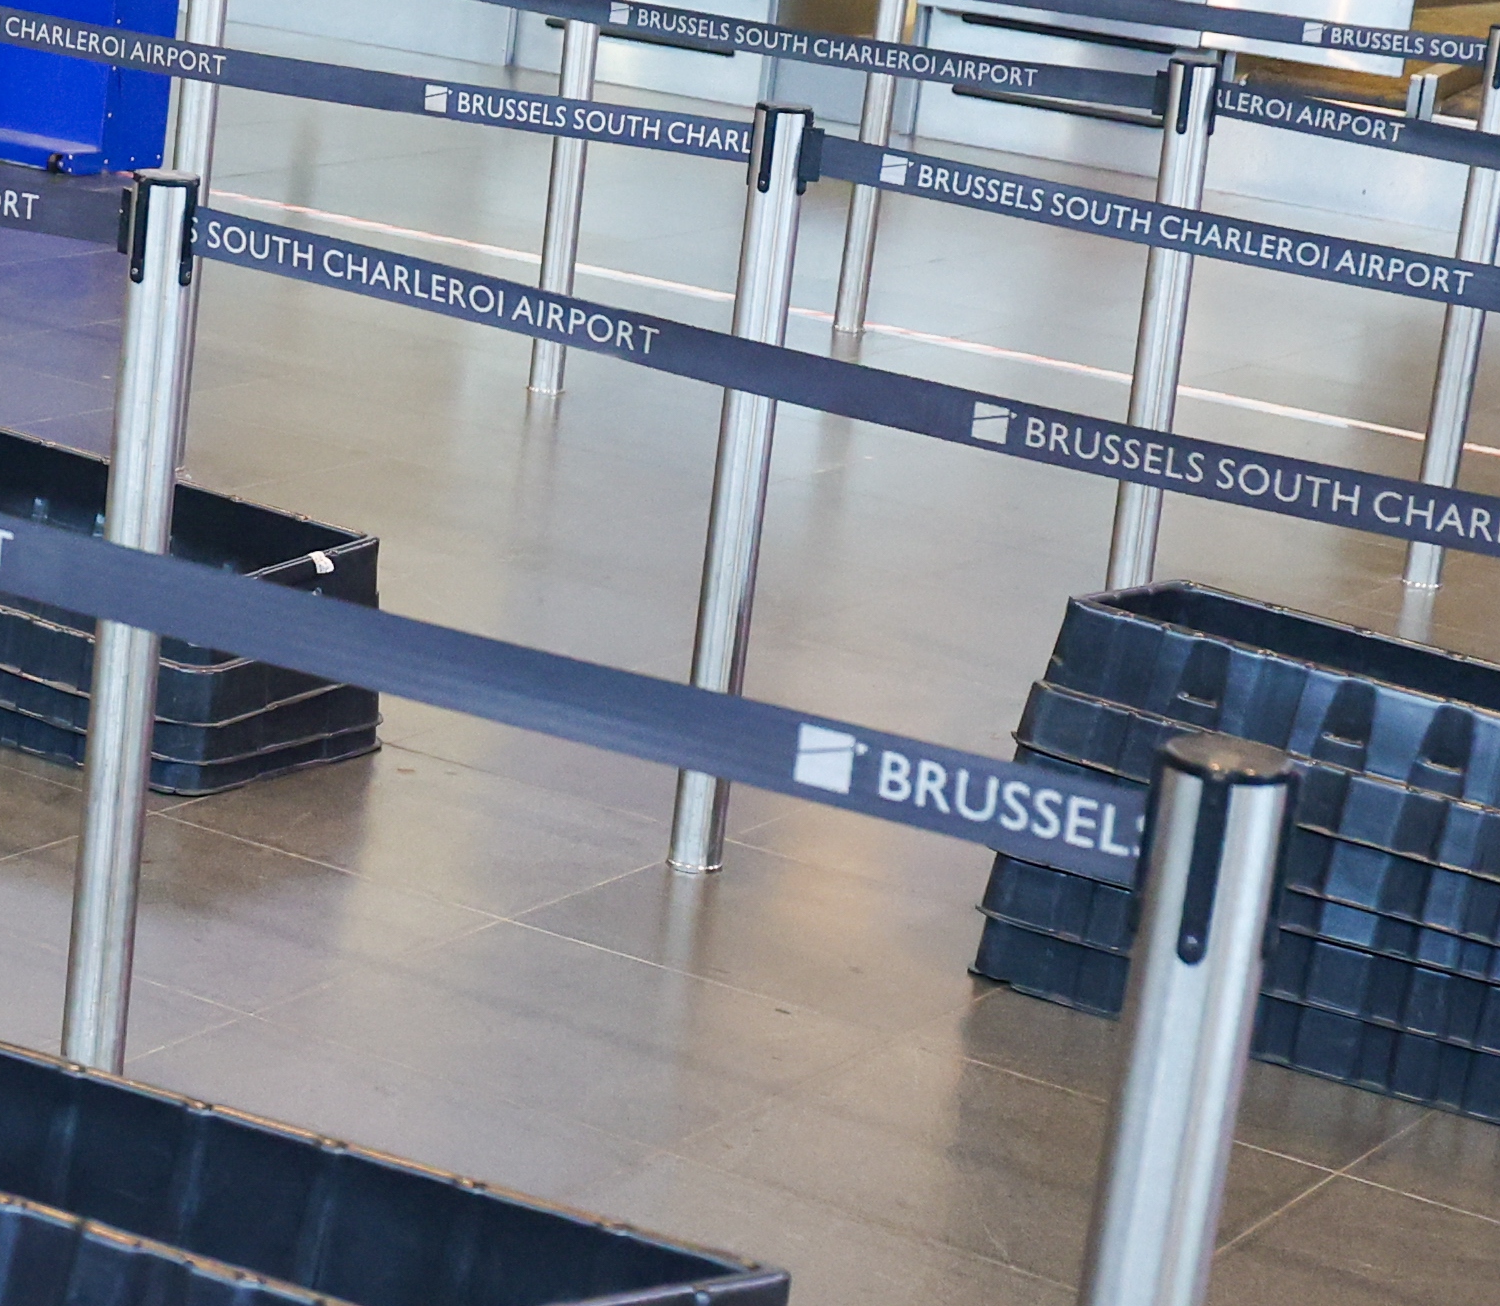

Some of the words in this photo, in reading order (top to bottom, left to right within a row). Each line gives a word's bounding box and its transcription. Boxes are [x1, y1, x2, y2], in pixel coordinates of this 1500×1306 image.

[5, 15, 127, 59] CHARLEROI
[129, 39, 227, 78] AIRPORT
[637, 7, 730, 43] BRUSSELS
[736, 26, 809, 55] SOUTH
[813, 38, 936, 75] CHARLEROI
[940, 58, 1039, 88] AIRPORT
[1330, 27, 1424, 55] BRUSSELS
[1430, 39, 1486, 62] SOUT
[456, 91, 566, 129] BRUSSELS
[572, 109, 660, 142] SOUTH
[667, 120, 750, 154] CHARL
[917, 163, 1044, 213] BRUSSELS
[1050, 191, 1151, 234] SOUTH
[1159, 215, 1329, 271] CHARLEROI
[1336, 250, 1473, 295] AIRPORT
[206, 220, 314, 272] SOUTH
[323, 249, 504, 318] CHARLEROI
[511, 296, 659, 356] AIRPORT
[1025, 415, 1204, 484] BRUSSELS
[1216, 458, 1361, 517] SOUTH
